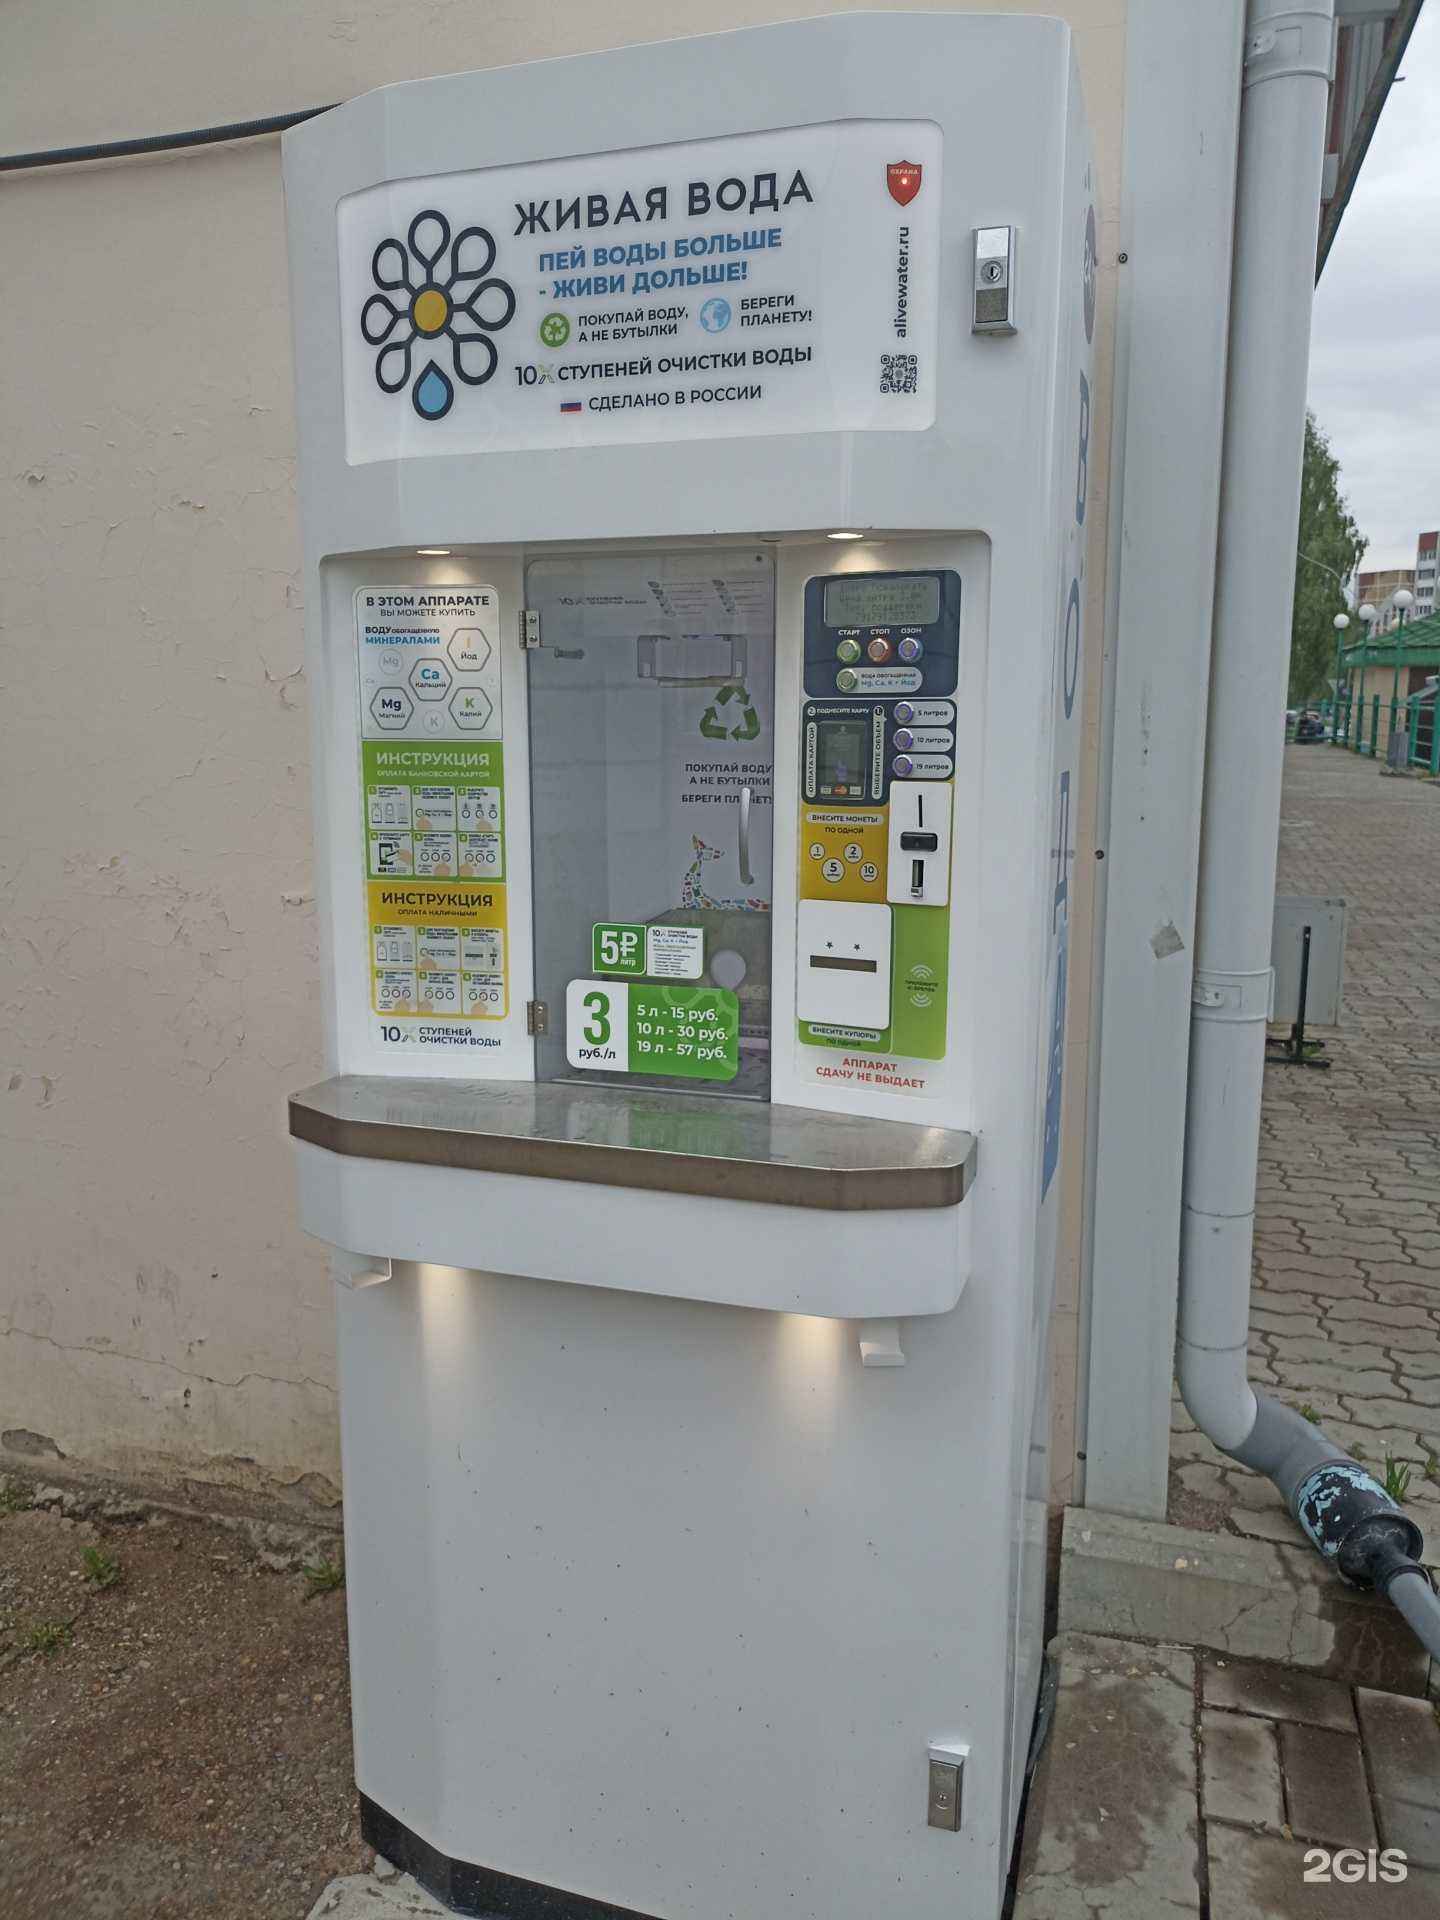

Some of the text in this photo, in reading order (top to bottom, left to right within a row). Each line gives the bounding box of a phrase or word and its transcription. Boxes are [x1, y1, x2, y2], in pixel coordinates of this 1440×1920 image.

[513, 169, 813, 236] ЖИВАЯ ВОДА
[539, 228, 782, 272] ПЕЙ ВОДЫ БОЛЬШЕ
[553, 274, 625, 299] ЖИВИ
[632, 261, 748, 295] ДОЛЬШЕ!
[893, 226, 909, 339] alivewater.ru
[740, 294, 795, 310] БЕРЕГИ
[578, 307, 689, 328] ПОКУПАЙ ВОДУ,
[740, 310, 813, 328] ПЛАНЕТУ!
[578, 324, 678, 343] А НЕ БУТЫЛКИ
[558, 357, 652, 382] СТУПЕНЕЙ
[657, 351, 746, 373] ОЧИСТКИ
[752, 346, 812, 366] ВОДЫ
[588, 385, 762, 412] СДЕЛАНО В РОССИИ
[366, 595, 490, 607] В ЭТОМ АППАРАТЕ
[380, 608, 476, 617] ВЫ МОЖЕТЕ КУПИТЬ
[365, 636, 440, 645] МИНЕРАЛАМИ
[460, 651, 478, 661] Йод
[421, 668, 440, 680] Ca
[382, 699, 402, 712] Mg
[377, 752, 490, 767] ИНСТРУКЦИЯ
[685, 762, 739, 773] ПОКУПАЙ
[689, 776, 698, 785] А
[717, 776, 770, 785] БУТЫЛКИ
[681, 794, 721, 803] БЕРЕГИ
[845, 815, 878, 823] МОНЕТЫ
[838, 826, 864, 834] ОДНОЙ
[850, 846, 857, 855] 2
[830, 863, 838, 872] 5
[864, 865, 875, 874] 10
[382, 893, 493, 908] ИНСТРУКЦИЯ
[583, 991, 611, 1045] 3
[636, 1005, 645, 1016] 5
[649, 1008, 658, 1017] л
[671, 1006, 685, 1018] 15
[689, 1009, 719, 1024] руб.
[419, 1026, 472, 1037] СТУПЕНЕЙ
[636, 1022, 651, 1034] 10
[655, 1026, 664, 1036] л
[677, 1025, 695, 1038] 30
[699, 1027, 729, 1042] руб.
[812, 1026, 877, 1040] ВНЕСИТЕ КУПЮРЫ
[419, 1035, 501, 1047] ОЧИСТКИ ВОДЫ
[579, 1048, 616, 1059] руб./л
[636, 1040, 651, 1052] 19
[654, 1045, 664, 1054] л
[676, 1044, 694, 1055] 57
[697, 1045, 727, 1059] руб.
[842, 1058, 897, 1071] АППАРАТ
[816, 1066, 925, 1089] СДАЧУ НЕ ВЫДАЕТ
